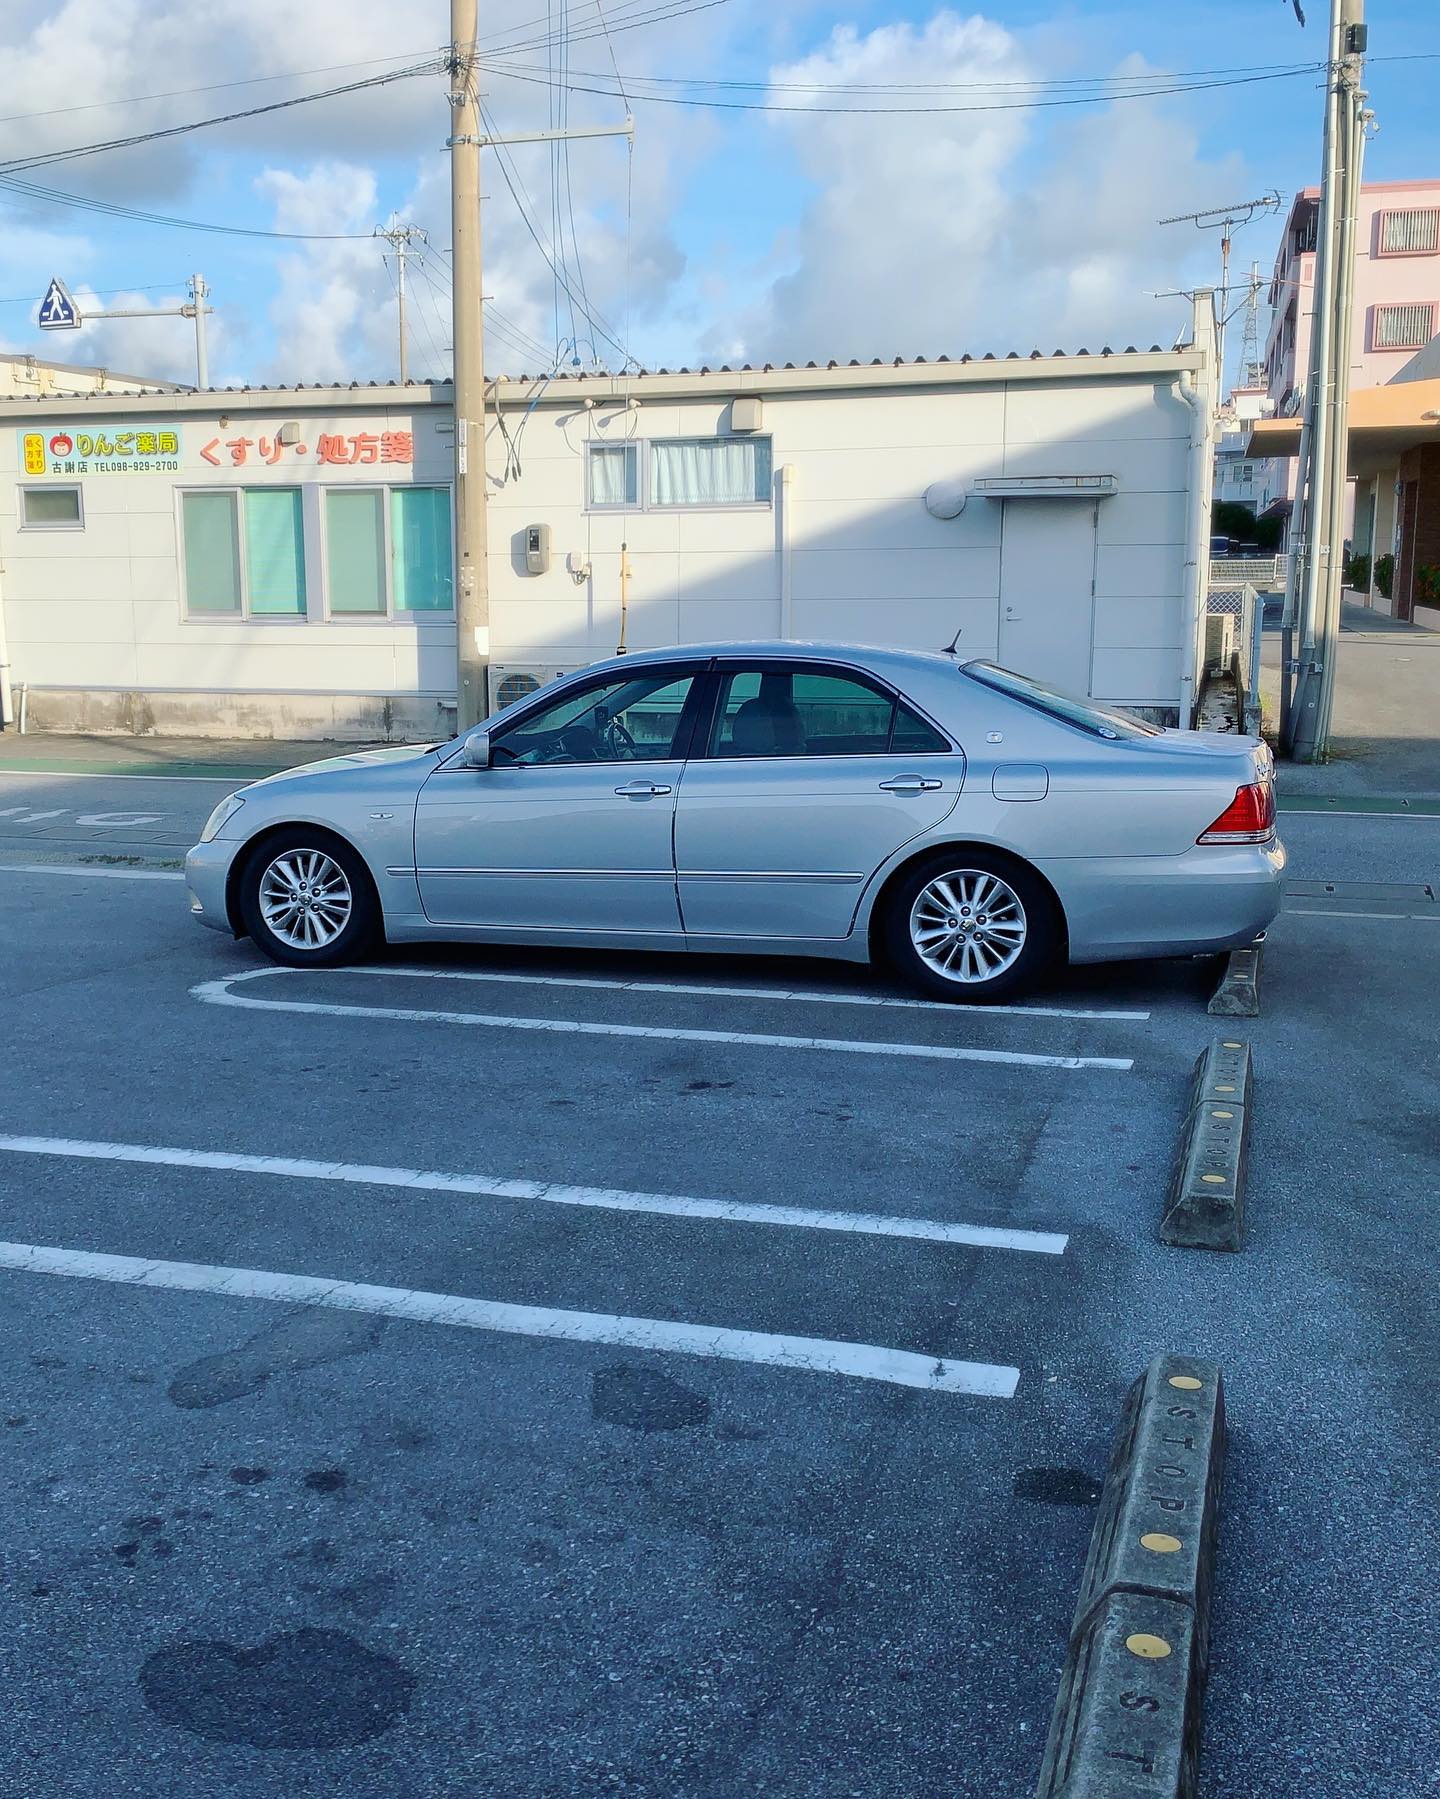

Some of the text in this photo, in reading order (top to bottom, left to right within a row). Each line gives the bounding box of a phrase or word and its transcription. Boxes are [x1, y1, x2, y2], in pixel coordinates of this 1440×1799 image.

[34, 439, 43, 469] くすり
[77, 431, 178, 457] りんご薬局
[52, 461, 88, 474] 古謝店
[1205, 1124, 1231, 1168] STOP
[1151, 1406, 1197, 1512] STOP
